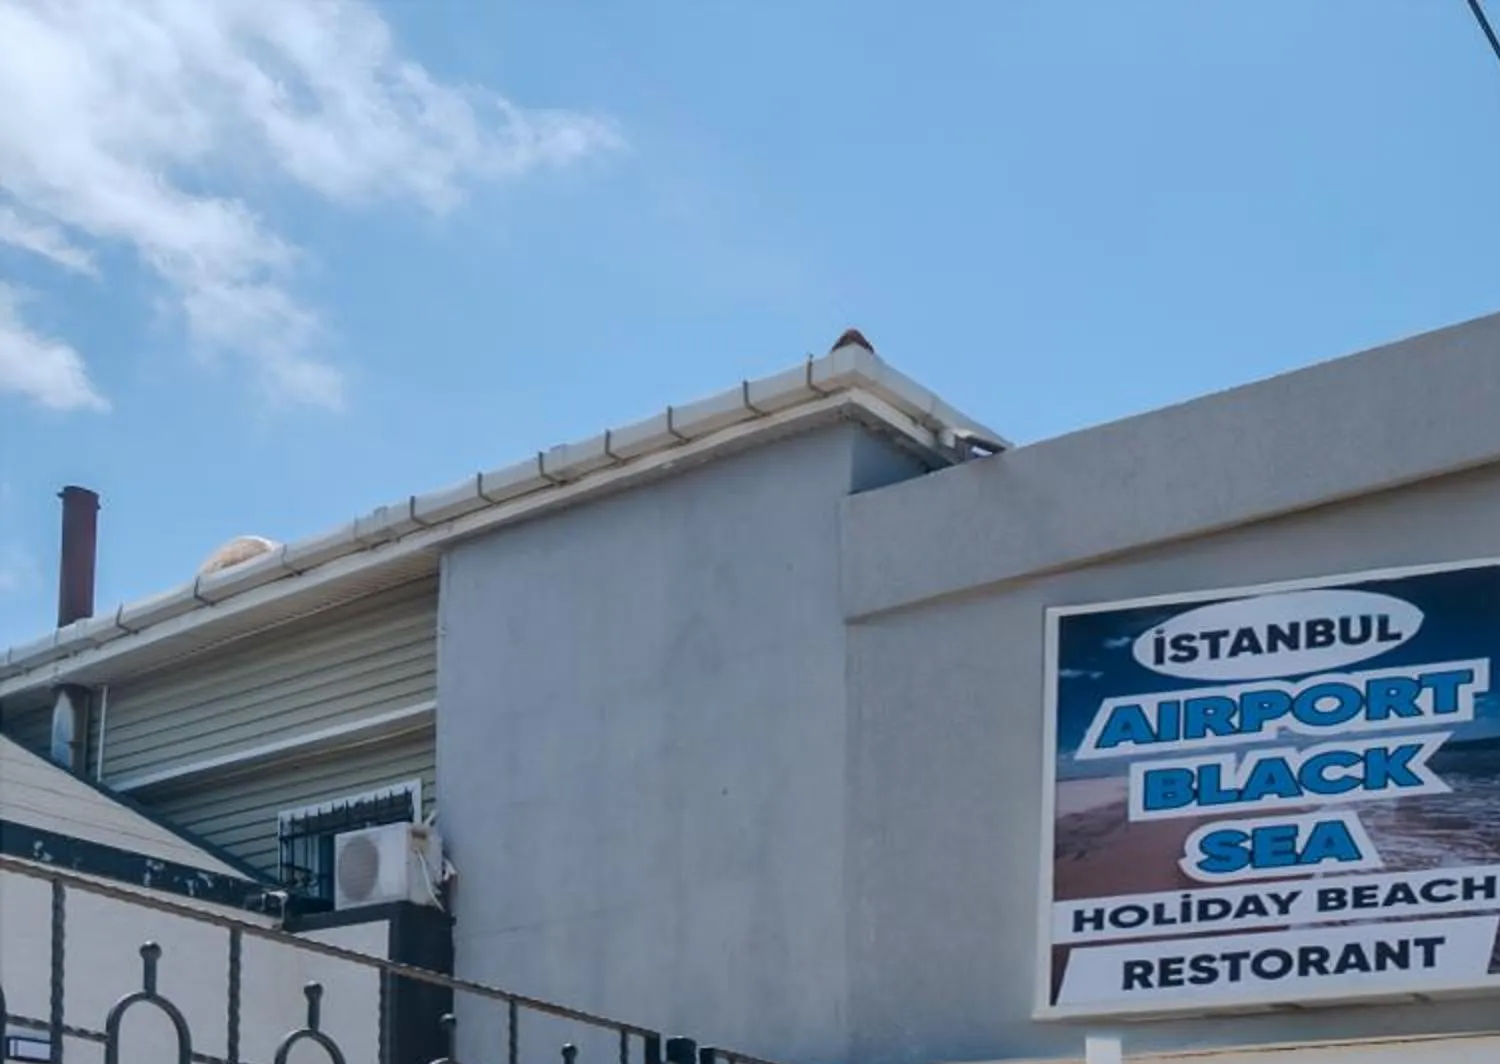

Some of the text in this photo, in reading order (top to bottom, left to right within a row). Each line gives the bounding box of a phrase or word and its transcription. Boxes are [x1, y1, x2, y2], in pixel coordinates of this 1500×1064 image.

[1153, 614, 1402, 666] İSTANBUL
[1094, 670, 1474, 749] AIRPORT
[1143, 744, 1424, 811] BLACK
[1197, 820, 1363, 874] SEA
[1317, 875, 1497, 913] BEACH
[1122, 937, 1445, 991] RESTORANT
